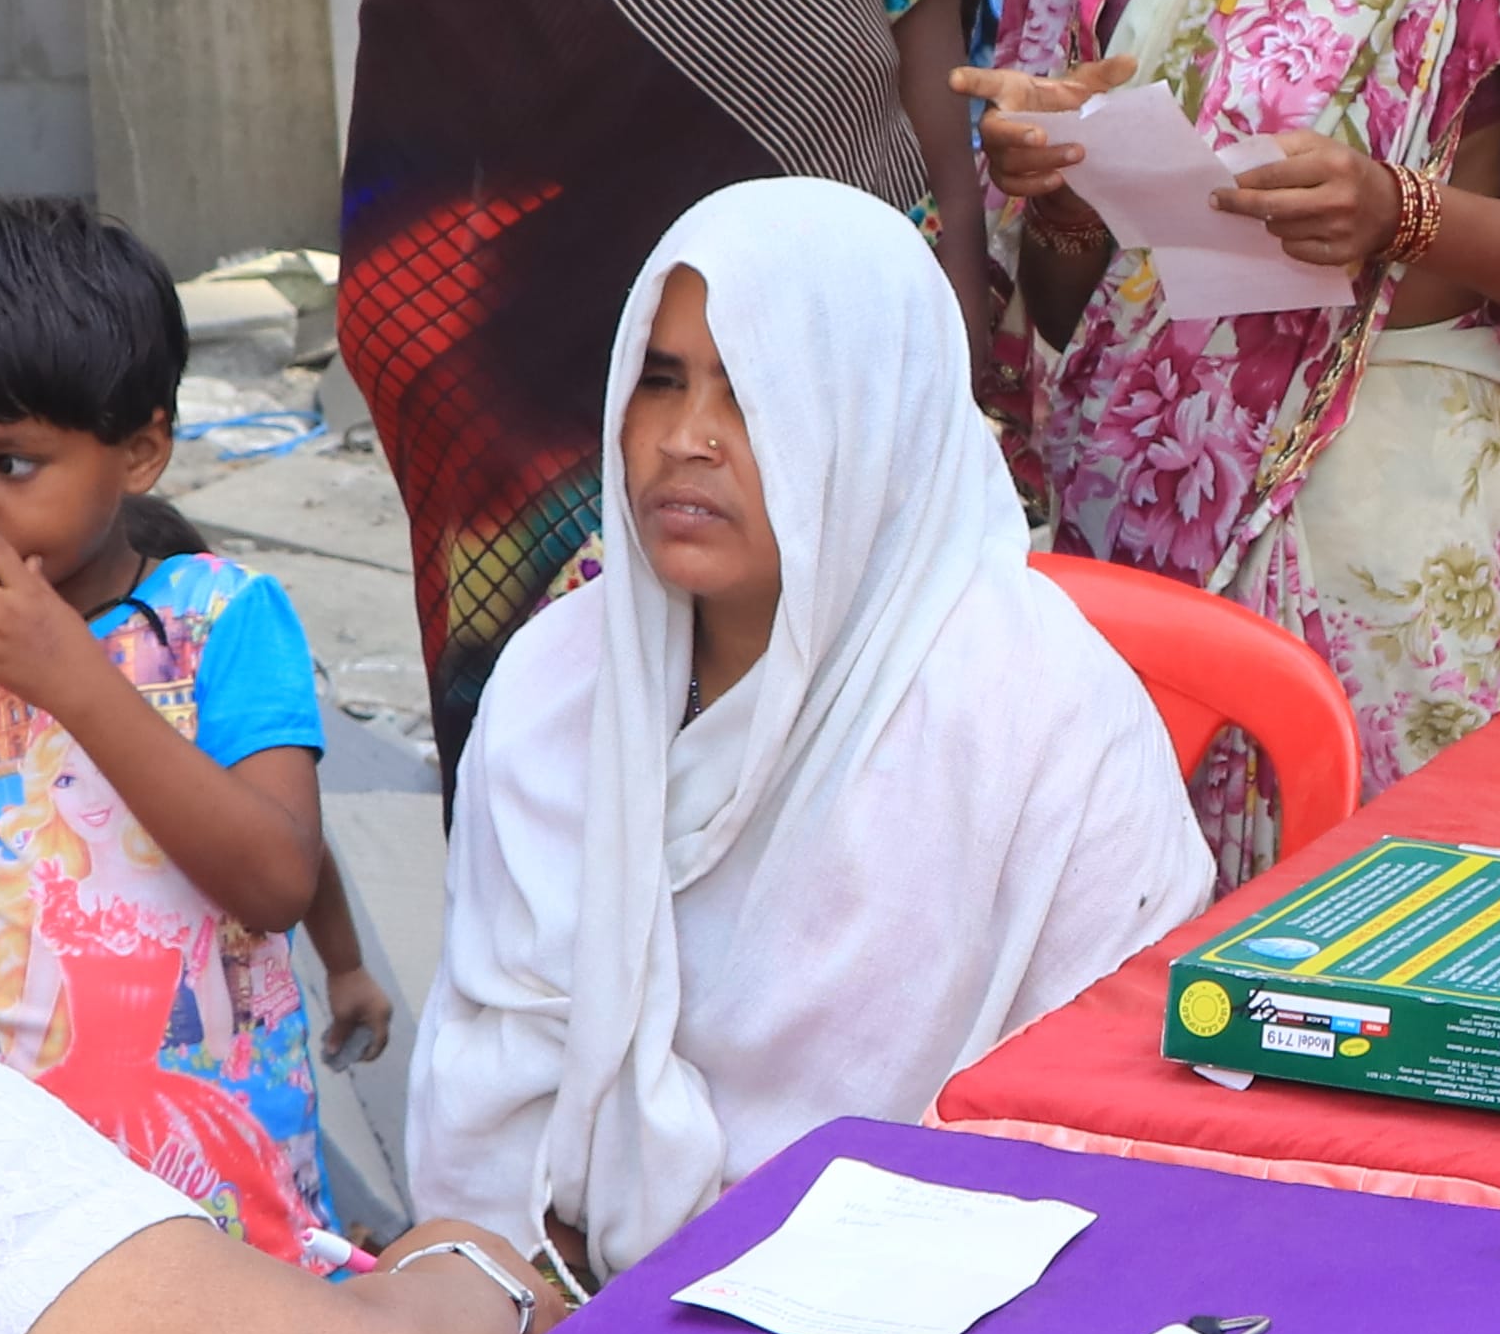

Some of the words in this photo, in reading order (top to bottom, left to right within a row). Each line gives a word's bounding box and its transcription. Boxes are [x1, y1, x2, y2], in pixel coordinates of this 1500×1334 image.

[1306, 1016, 1331, 1026] BLACK
[1267, 1030, 1293, 1047] 719
[1298, 1034, 1332, 1052] Model
[1433, 1087, 1470, 1099] COMPANY
[1470, 1092, 1495, 1102] SCALE
